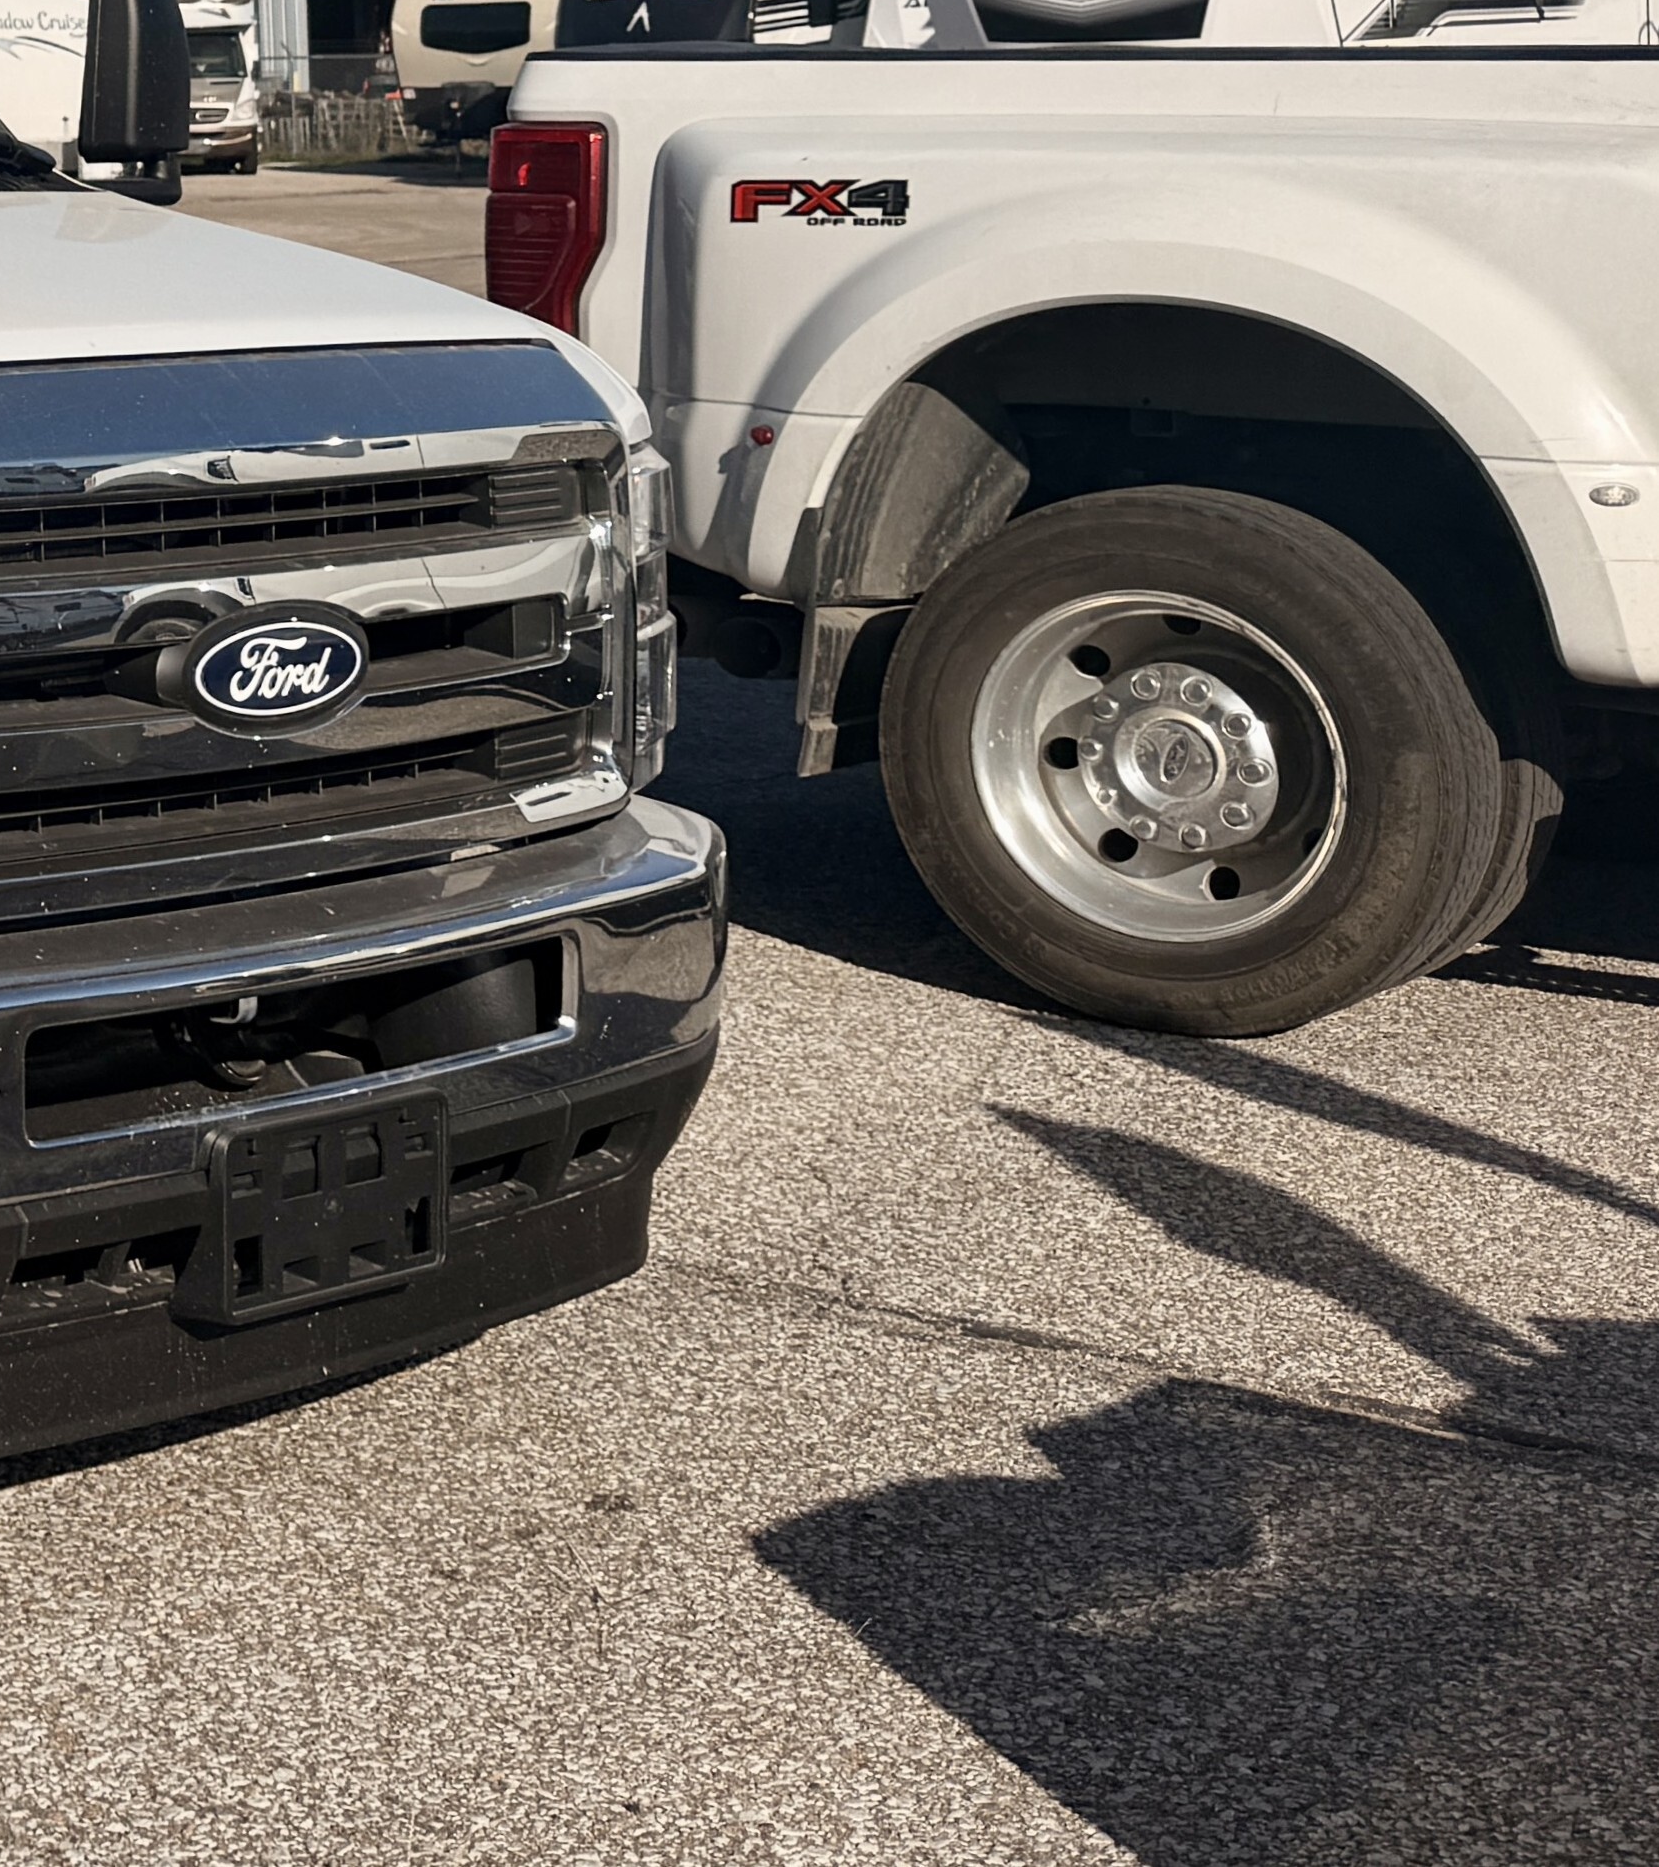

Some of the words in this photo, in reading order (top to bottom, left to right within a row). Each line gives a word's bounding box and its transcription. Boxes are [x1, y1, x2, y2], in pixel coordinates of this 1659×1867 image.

[37, 10, 87, 36] Cruise
[730, 179, 910, 223] FX4
[807, 217, 846, 226] OFF
[853, 217, 907, 226] ROAD
[230, 636, 333, 702] Ford
